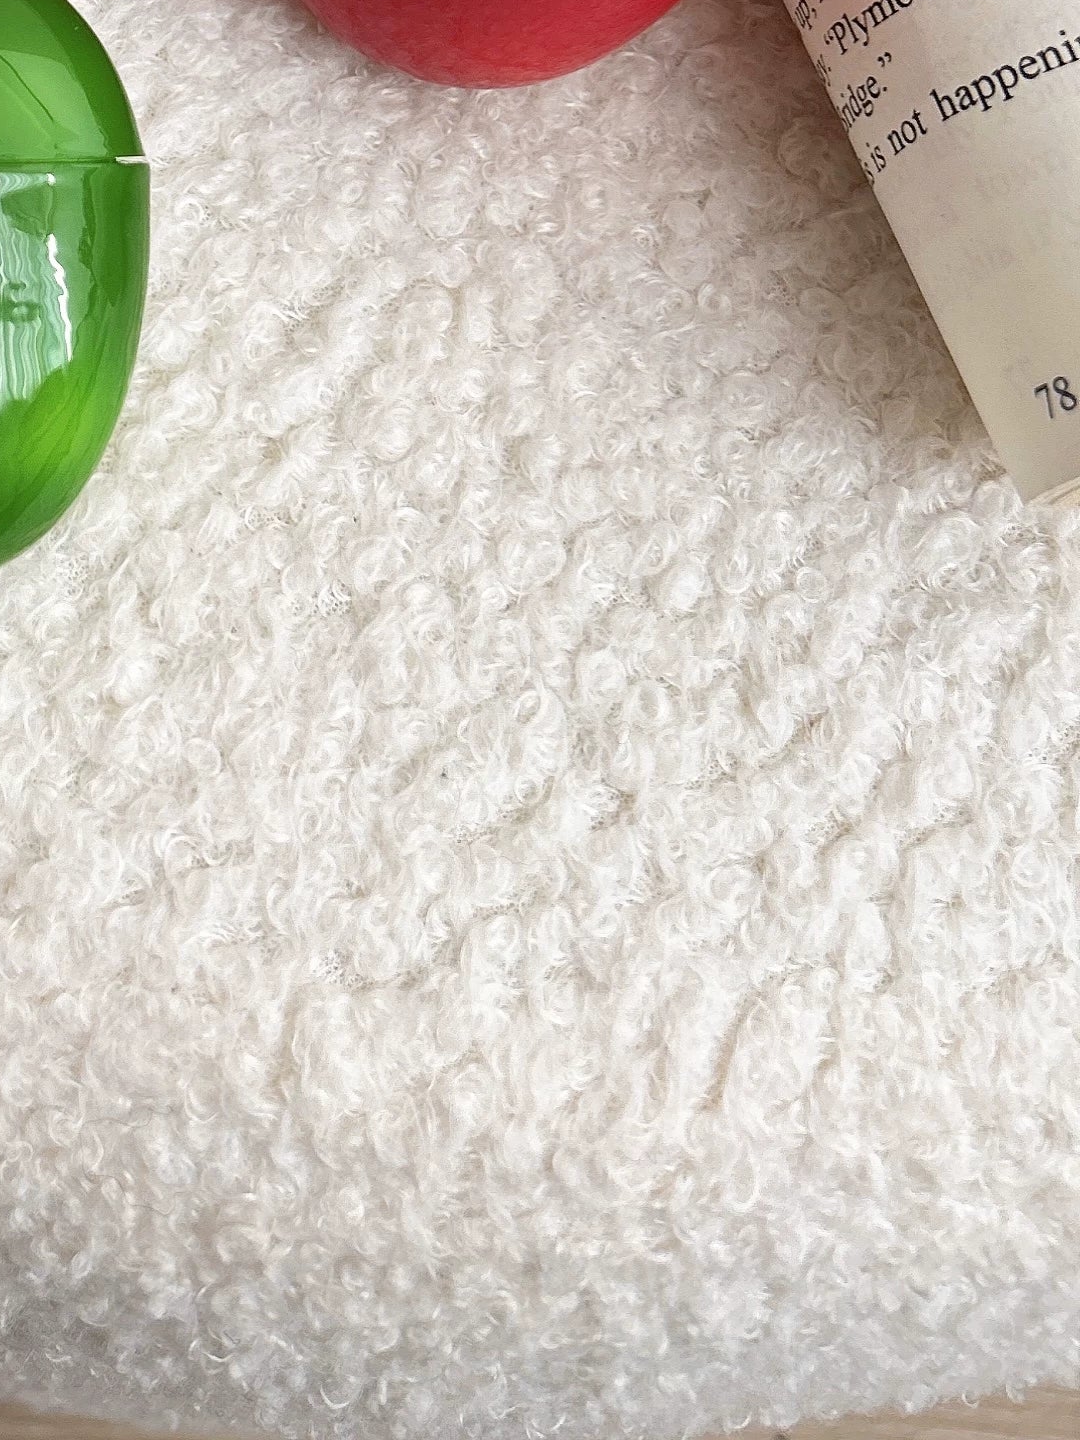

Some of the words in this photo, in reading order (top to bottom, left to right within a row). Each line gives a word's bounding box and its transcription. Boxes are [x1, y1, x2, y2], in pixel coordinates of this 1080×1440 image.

[865, 142, 887, 173] is
[887, 108, 928, 156] not
[929, 29, 1080, 121] happeni
[1033, 376, 1078, 419] 78
